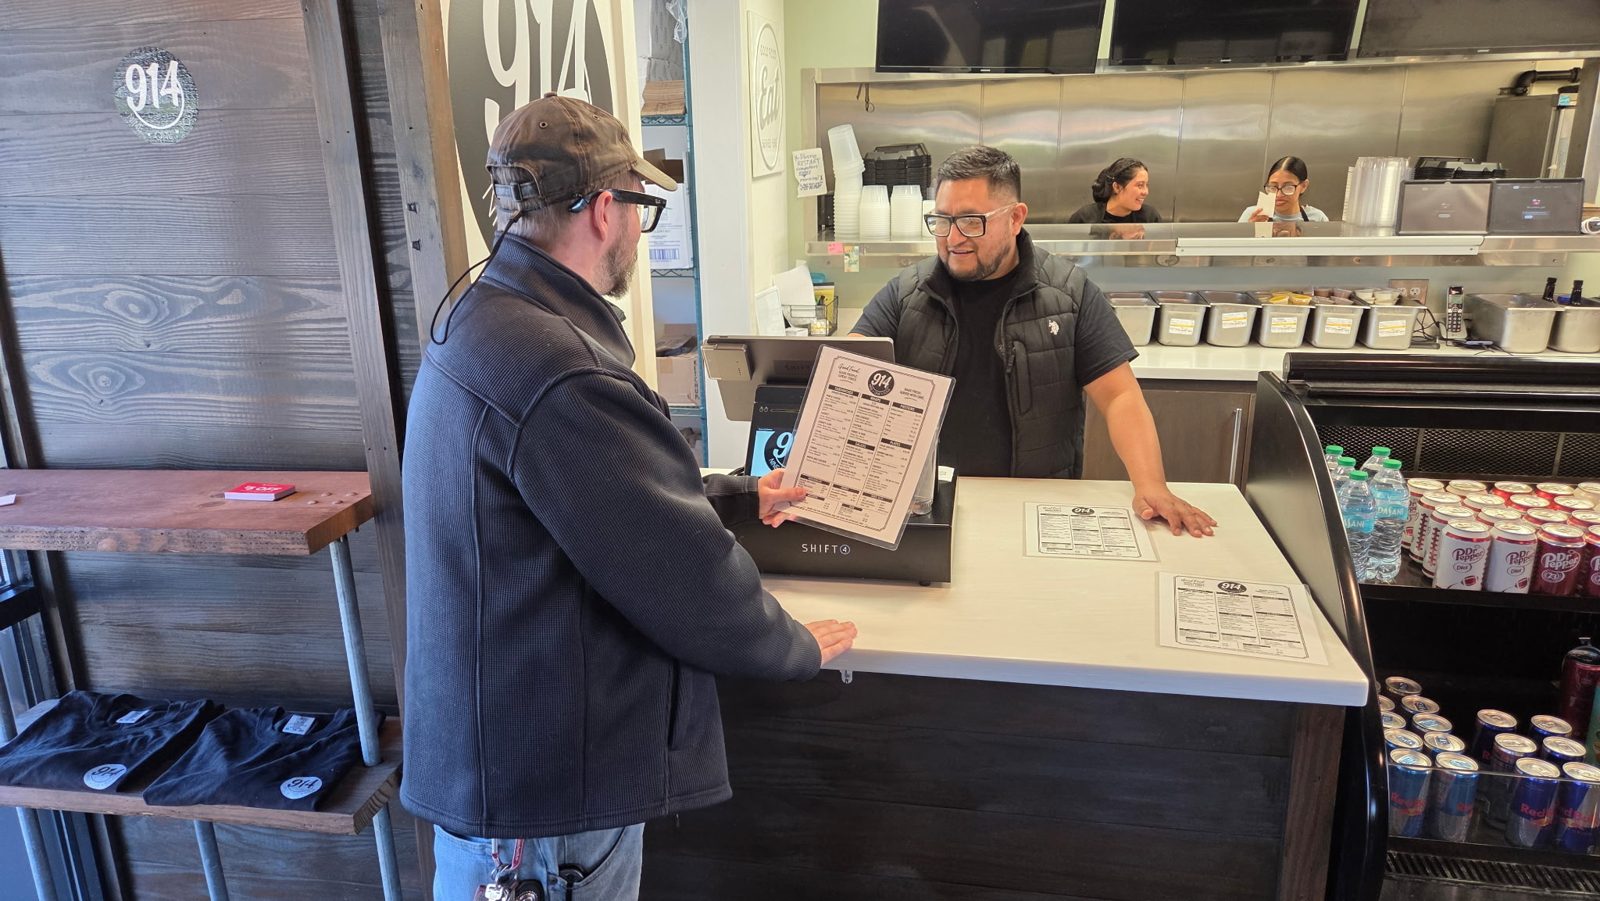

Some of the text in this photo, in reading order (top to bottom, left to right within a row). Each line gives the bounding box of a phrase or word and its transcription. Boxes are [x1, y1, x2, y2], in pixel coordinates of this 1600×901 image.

[125, 60, 185, 112] 914
[758, 64, 780, 131] Eat
[871, 372, 893, 389] 914
[1377, 506, 1404, 515] DASANI
[1455, 548, 1484, 562] Pepper
[1465, 547, 1478, 555] Dr
[1556, 552, 1573, 562] Dr
[1544, 552, 1579, 570] Pepper
[1221, 582, 1242, 590] 914
[287, 778, 320, 789] 914
